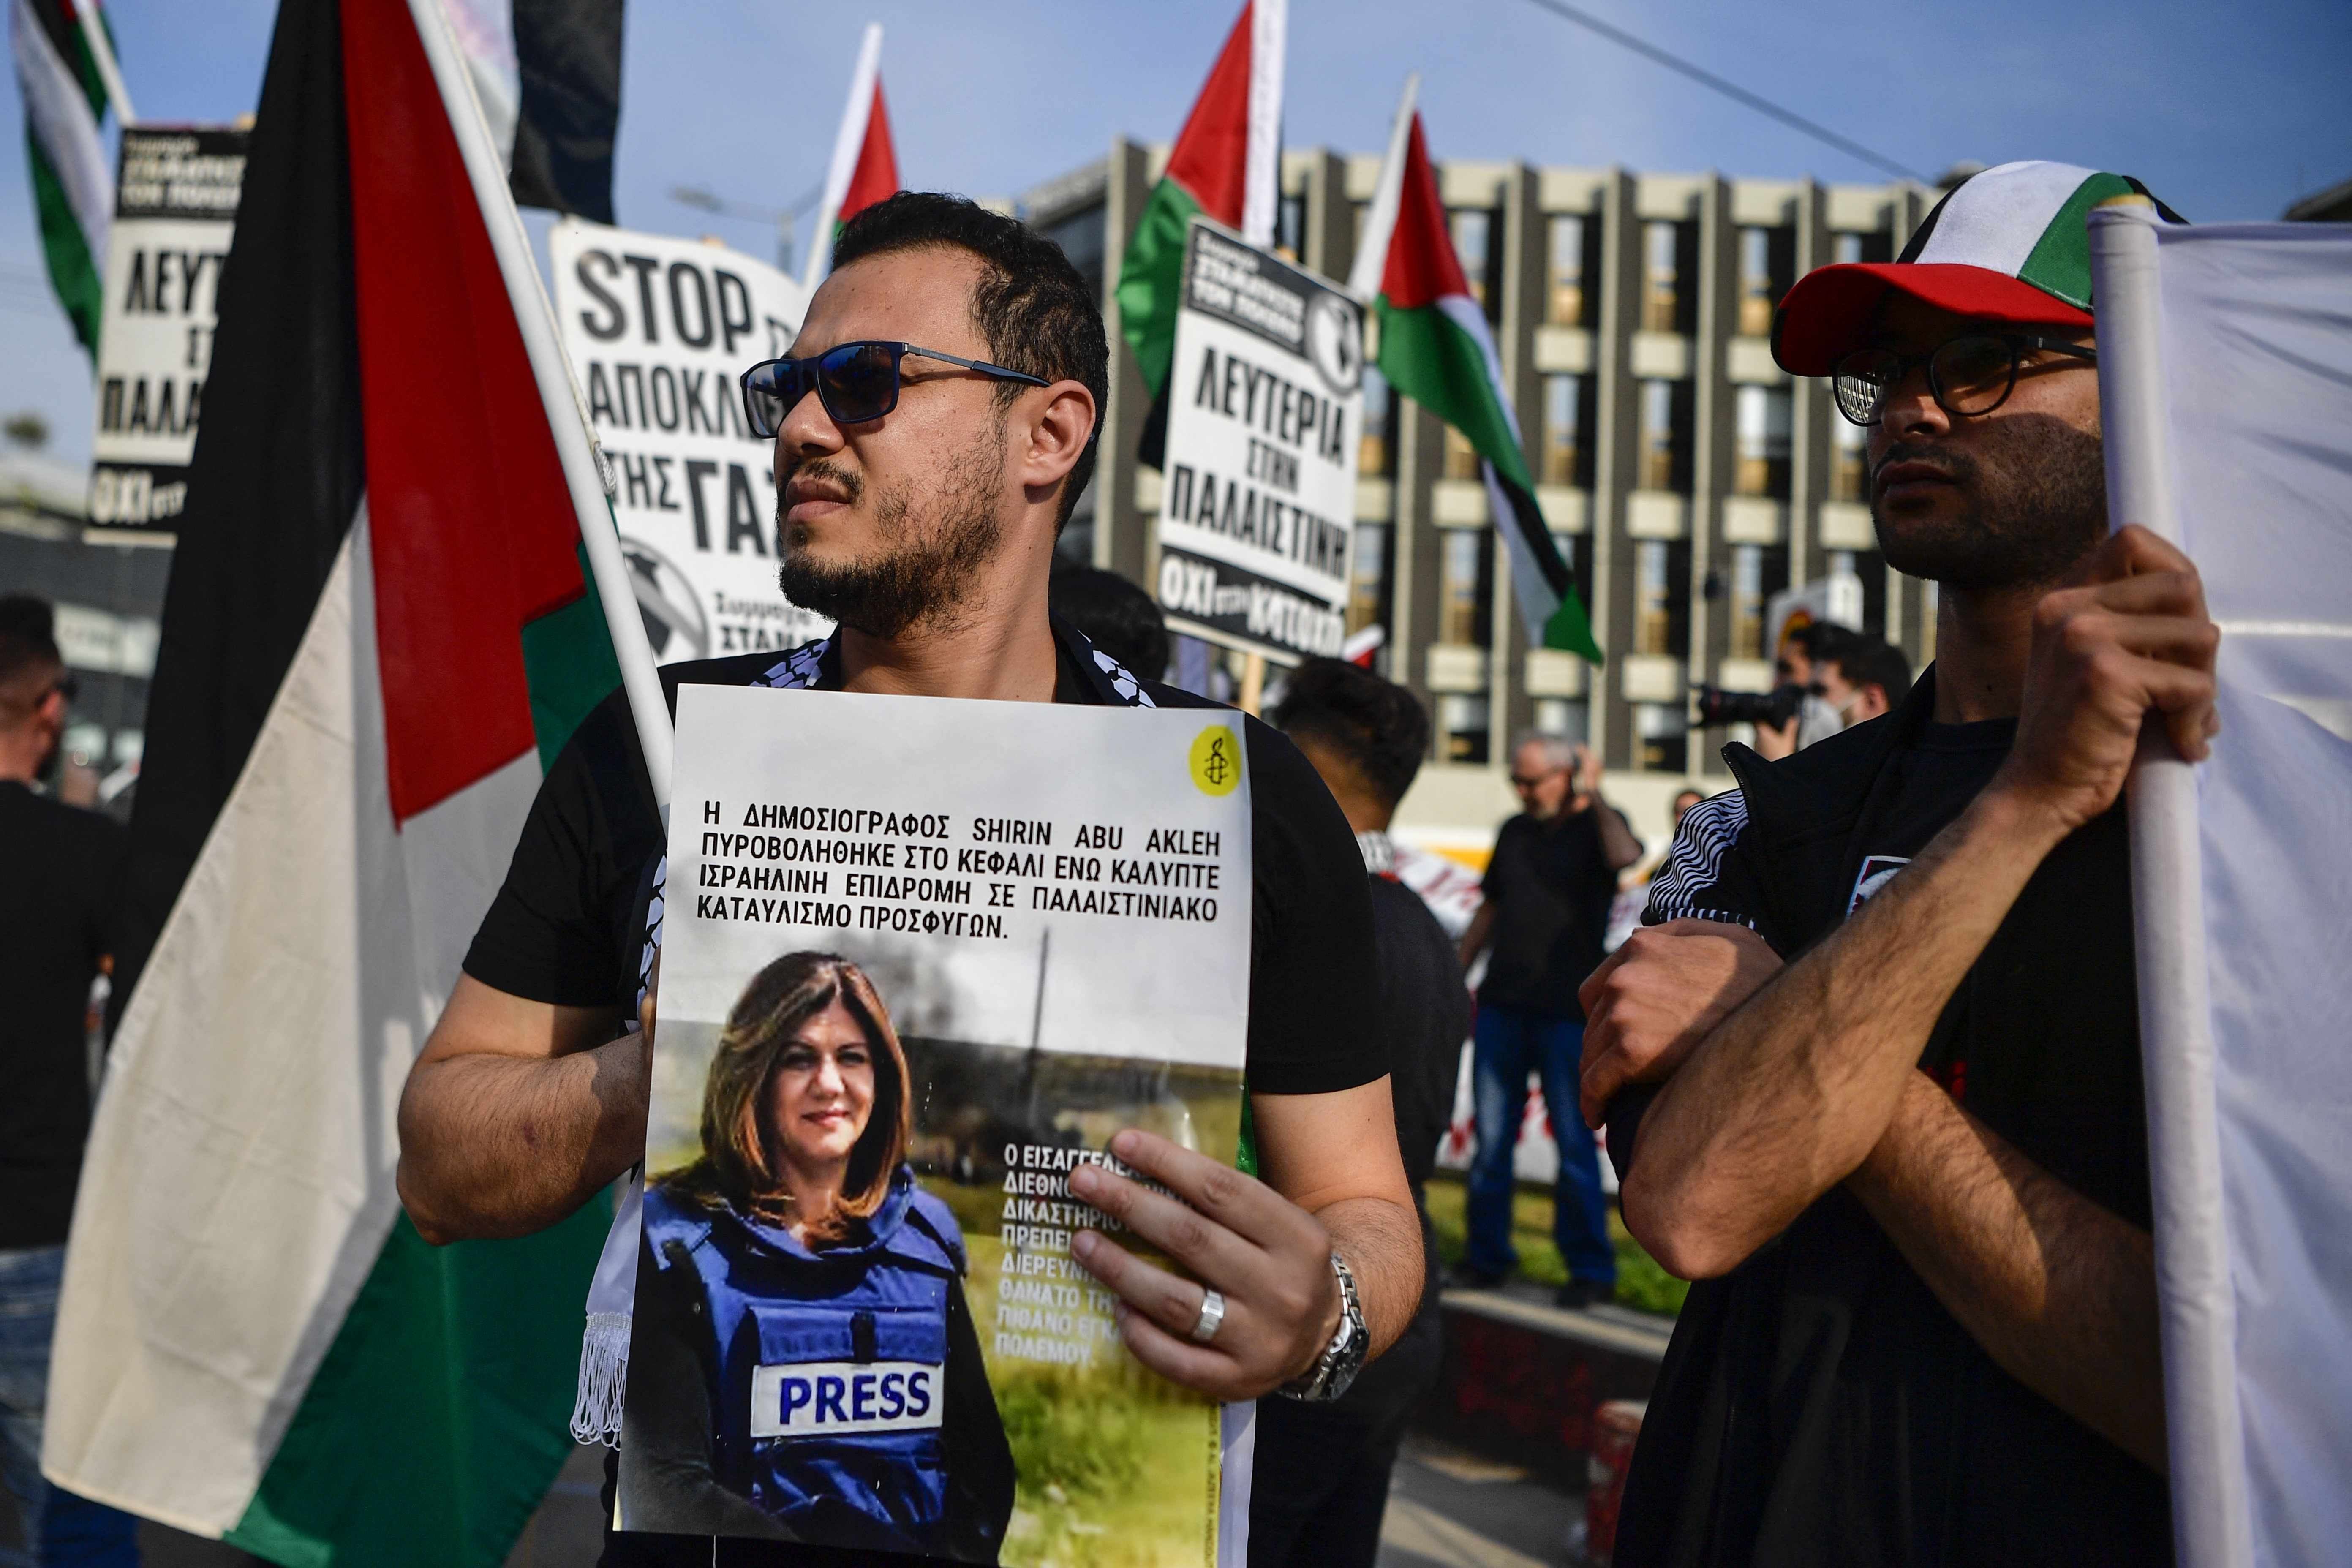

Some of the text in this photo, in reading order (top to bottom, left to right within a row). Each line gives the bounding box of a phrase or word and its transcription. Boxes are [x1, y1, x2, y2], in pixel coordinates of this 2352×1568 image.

[577, 248, 754, 354] STOP
[1196, 347, 1345, 469] ΛΕΥΤΕΡΙΑ
[684, 458, 787, 558] ΓΑ
[1171, 464, 1348, 582] ΠΑΛΑΙΣΤΙΝΗ
[1160, 555, 1217, 618] ΟΧΙ
[704, 800, 1220, 857] Η ΔΗΜΟΣΙΟΓΡΑΦΟΣ SHIRIN ABU AKLEH
[702, 832, 1220, 890] ΠΥΡΟΒΟΛΗΘΗΚΕ ΣΤΟ ΚΕΦΑΛΙ ΕΝΩ ΚΑΛΥΠΤΕ
[697, 894, 1007, 939] ΚΑΤΑΥΛΙΣΜΟ ΠΡΟΣΦΥΓΩΝ.
[699, 863, 1217, 922] ΙΣΡΑΗΛΙΝΗ ΕΠΙΔΡΟΜΗ ΣΕ ΠΑΛΑΙΣΤΙΝΙΑΚΟ
[1004, 1143, 1018, 1166] Ο
[1002, 1223, 1072, 1252] ΠΡΕΠΕΙ
[996, 1304, 1072, 1336] ΠΙΘΑΝΟ
[999, 1278, 1080, 1309] ΘΑΝΑΤΟ
[780, 1371, 930, 1425] PRESS
